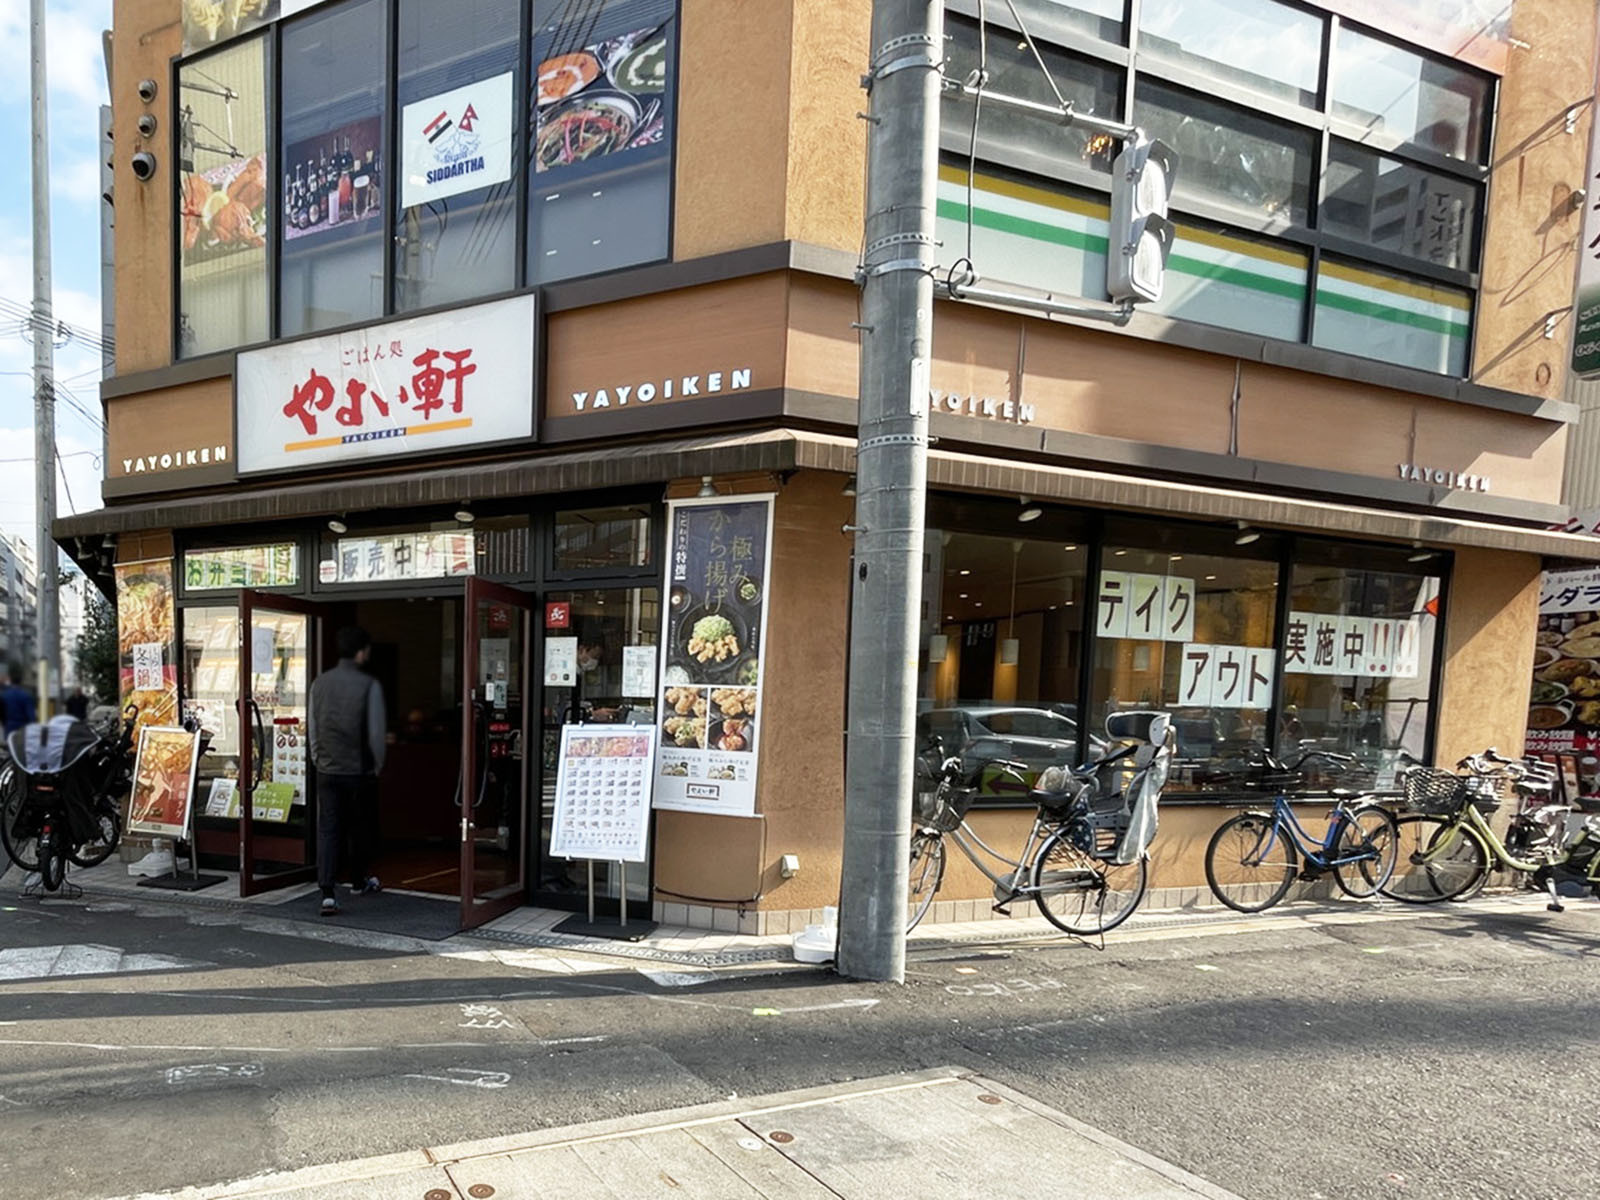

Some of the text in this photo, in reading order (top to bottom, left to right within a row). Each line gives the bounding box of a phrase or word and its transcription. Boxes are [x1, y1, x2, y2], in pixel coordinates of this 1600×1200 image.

[426, 156, 485, 185] SIDDARTHA
[342, 340, 404, 366] ごはん処
[283, 348, 478, 436] やよい軒
[572, 368, 751, 411] YAYOIKEN
[343, 427, 407, 444] YAYOIKEN
[122, 445, 227, 473] YAYOIKEN
[1399, 463, 1491, 492] YAYOIKEN
[703, 509, 732, 614] から揚げ
[728, 534, 753, 586] 極み
[1099, 580, 1191, 634] テイク
[1186, 650, 1269, 702] アウト
